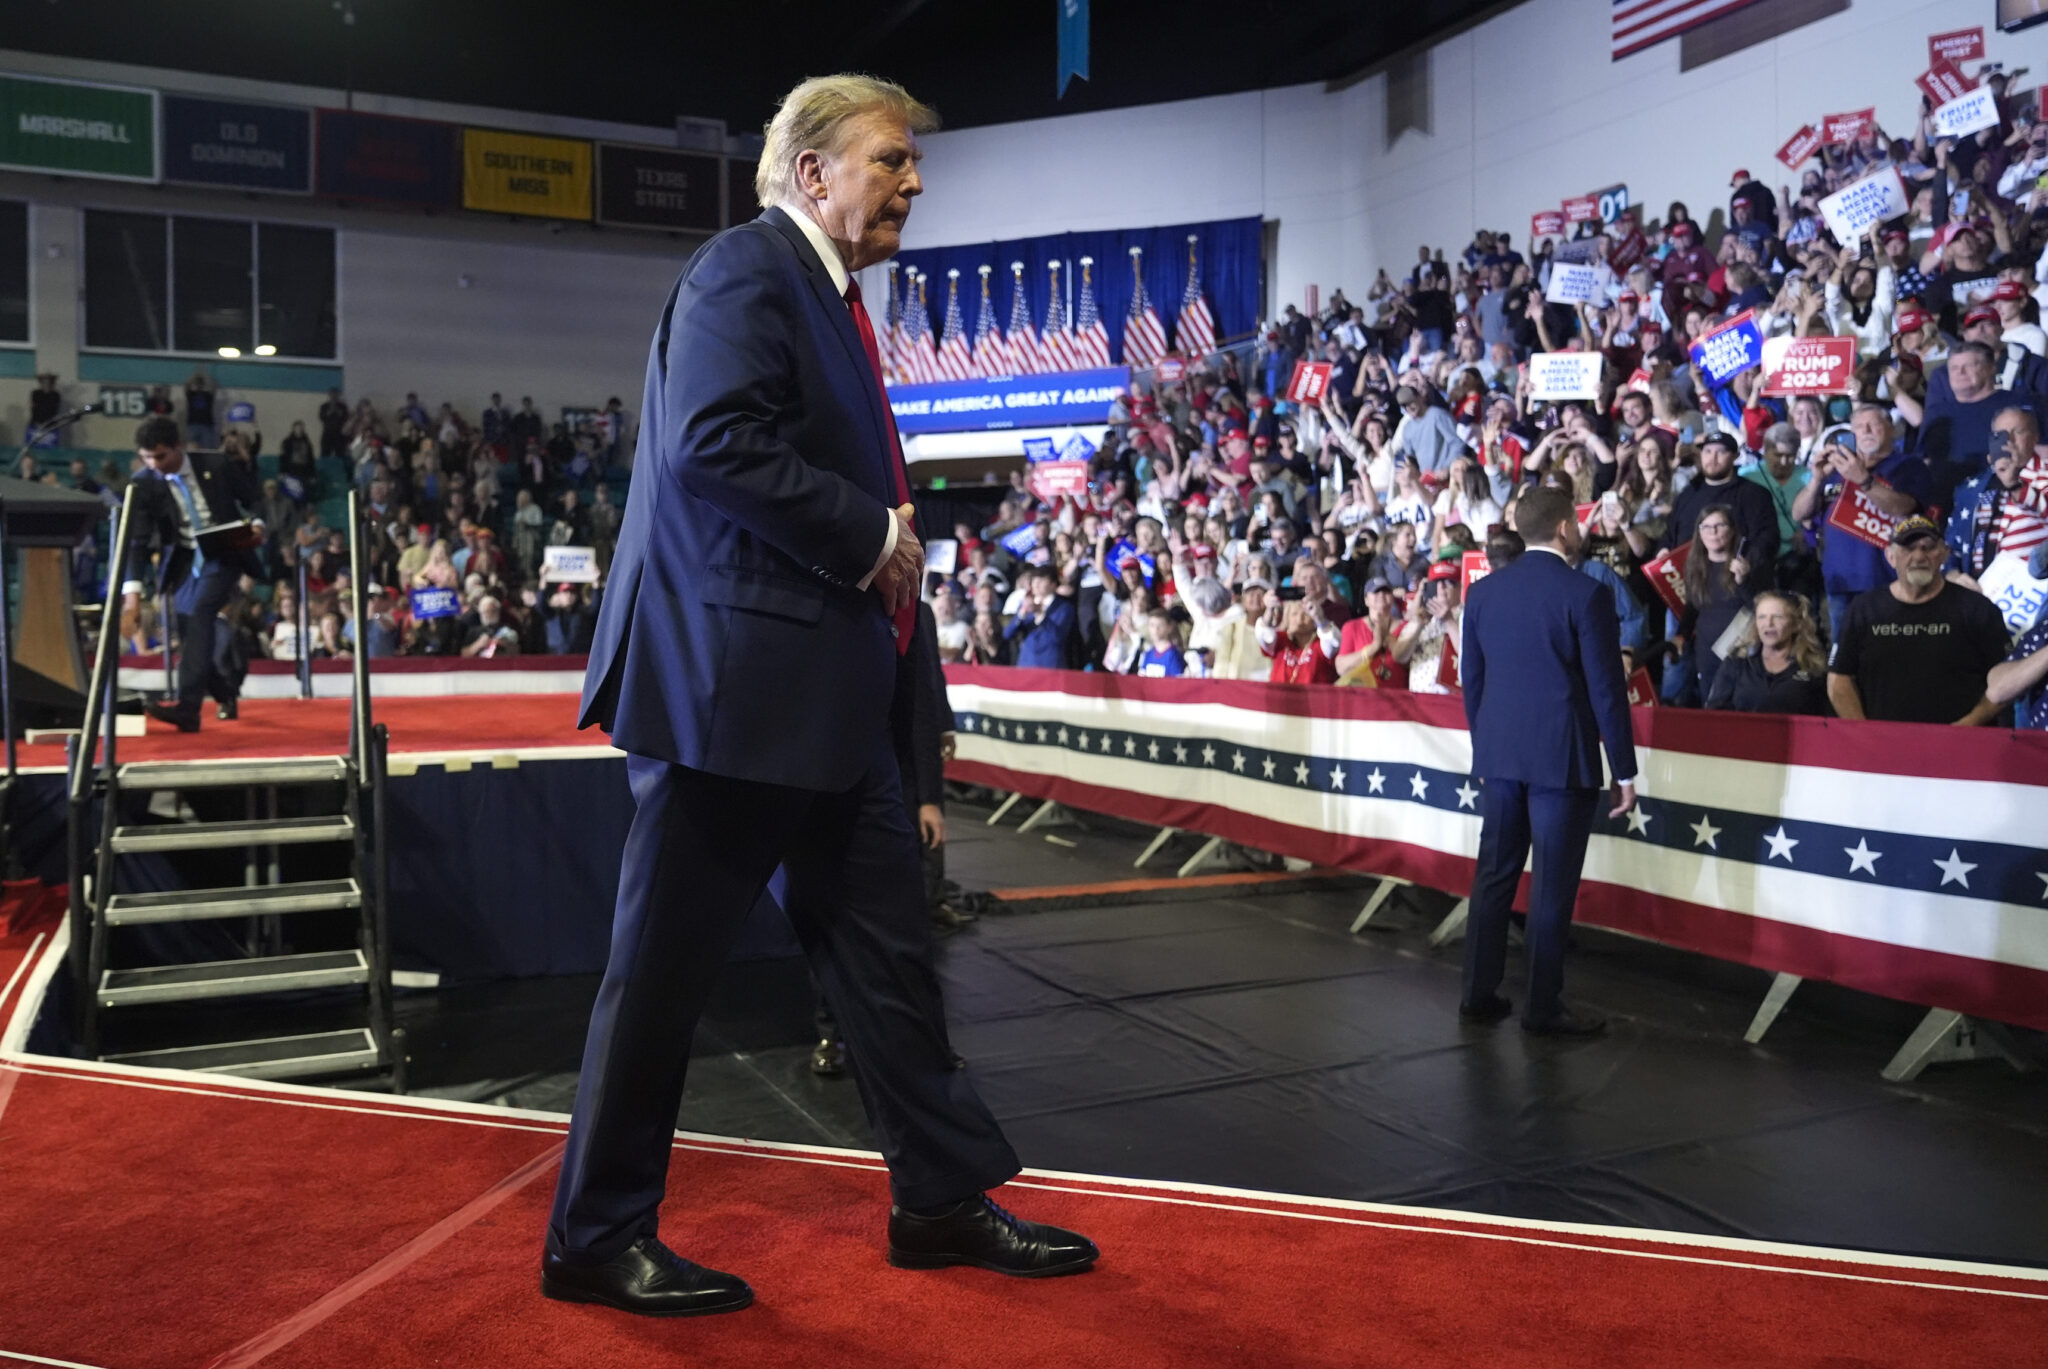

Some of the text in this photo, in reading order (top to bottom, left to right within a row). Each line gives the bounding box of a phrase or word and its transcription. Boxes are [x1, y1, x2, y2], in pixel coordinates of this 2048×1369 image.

[1940, 95, 1986, 120] TRUMP
[1948, 107, 1982, 128] 2024
[19, 113, 131, 143] MARSHALL
[220, 122, 258, 143] OLD
[191, 143, 285, 168] DOMINION
[484, 151, 574, 175] SOUTHERN
[508, 177, 549, 195] MISS
[636, 168, 688, 189] TEXAS
[635, 190, 687, 210] STATE
[1836, 186, 1891, 217] AMERICA
[1840, 182, 1877, 205] MAKE
[1847, 198, 1888, 222] GREAT
[1852, 205, 1892, 231] AGAIN!
[1699, 333, 1752, 369] AMERICA
[1703, 328, 1741, 352] MAKE
[1790, 343, 1826, 357] VOTE
[1550, 359, 1581, 367] MAKE
[1706, 343, 1746, 373] GREAT
[1711, 352, 1751, 381] AGAIN!
[1541, 367, 1589, 375] AMERICA
[1546, 376, 1581, 384] GREAT
[1781, 371, 1831, 388] 2024
[102, 391, 145, 415] 115
[890, 387, 1118, 416] MAKE AMERICA GREAT AGAIN
[1854, 489, 1902, 525] TRU
[1853, 511, 1893, 541] 202
[1995, 584, 2024, 612] 20
[2008, 587, 2048, 636] TRU
